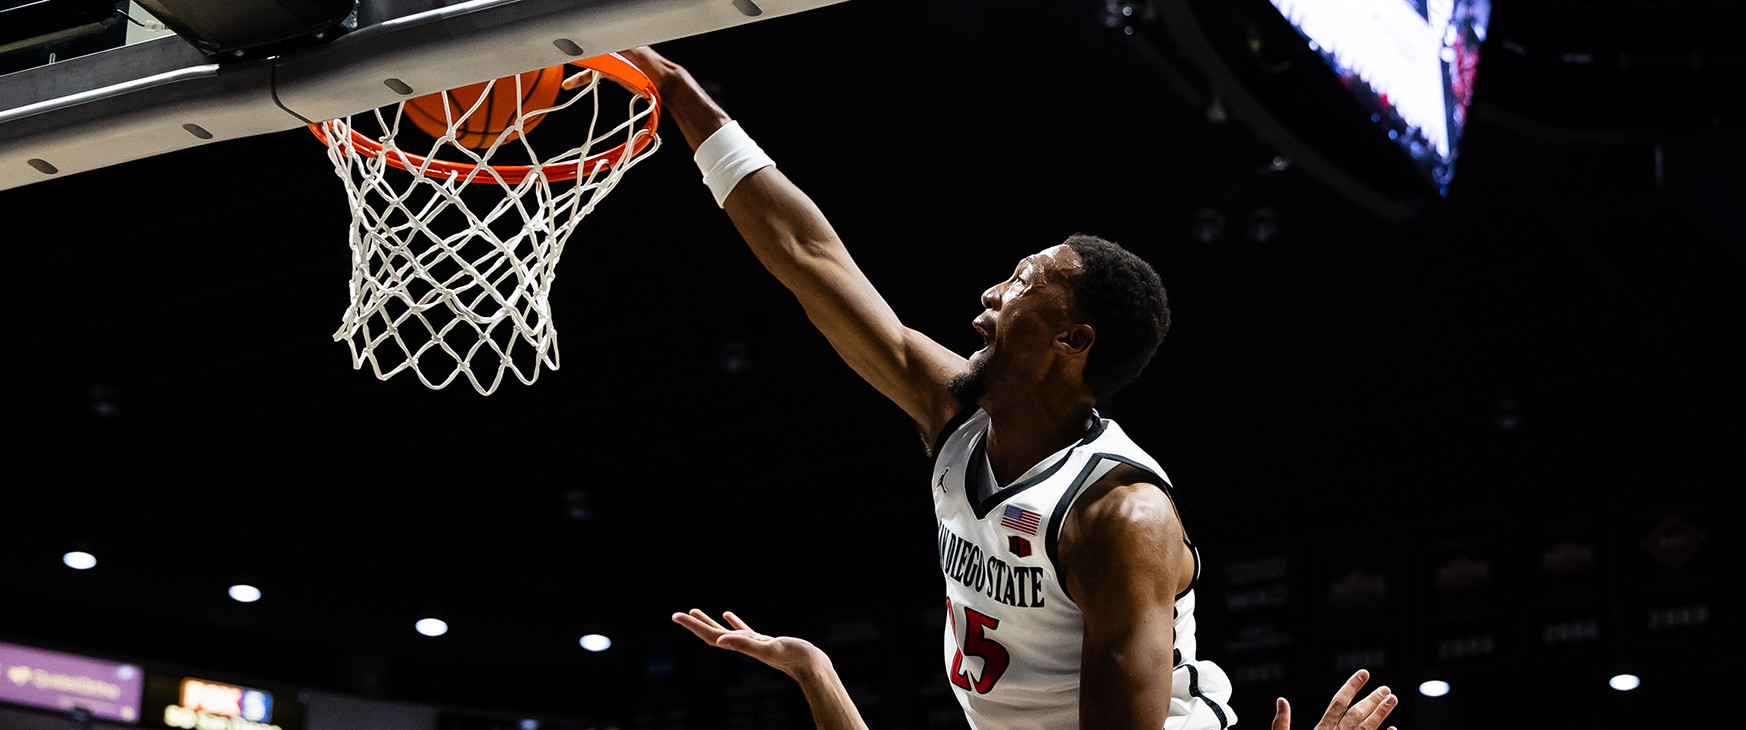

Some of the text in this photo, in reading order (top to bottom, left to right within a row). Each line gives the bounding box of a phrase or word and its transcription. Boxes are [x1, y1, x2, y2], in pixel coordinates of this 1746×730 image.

[945, 531, 986, 593] DIEGO
[986, 555, 1045, 608] STATE
[945, 596, 1010, 694] 25
